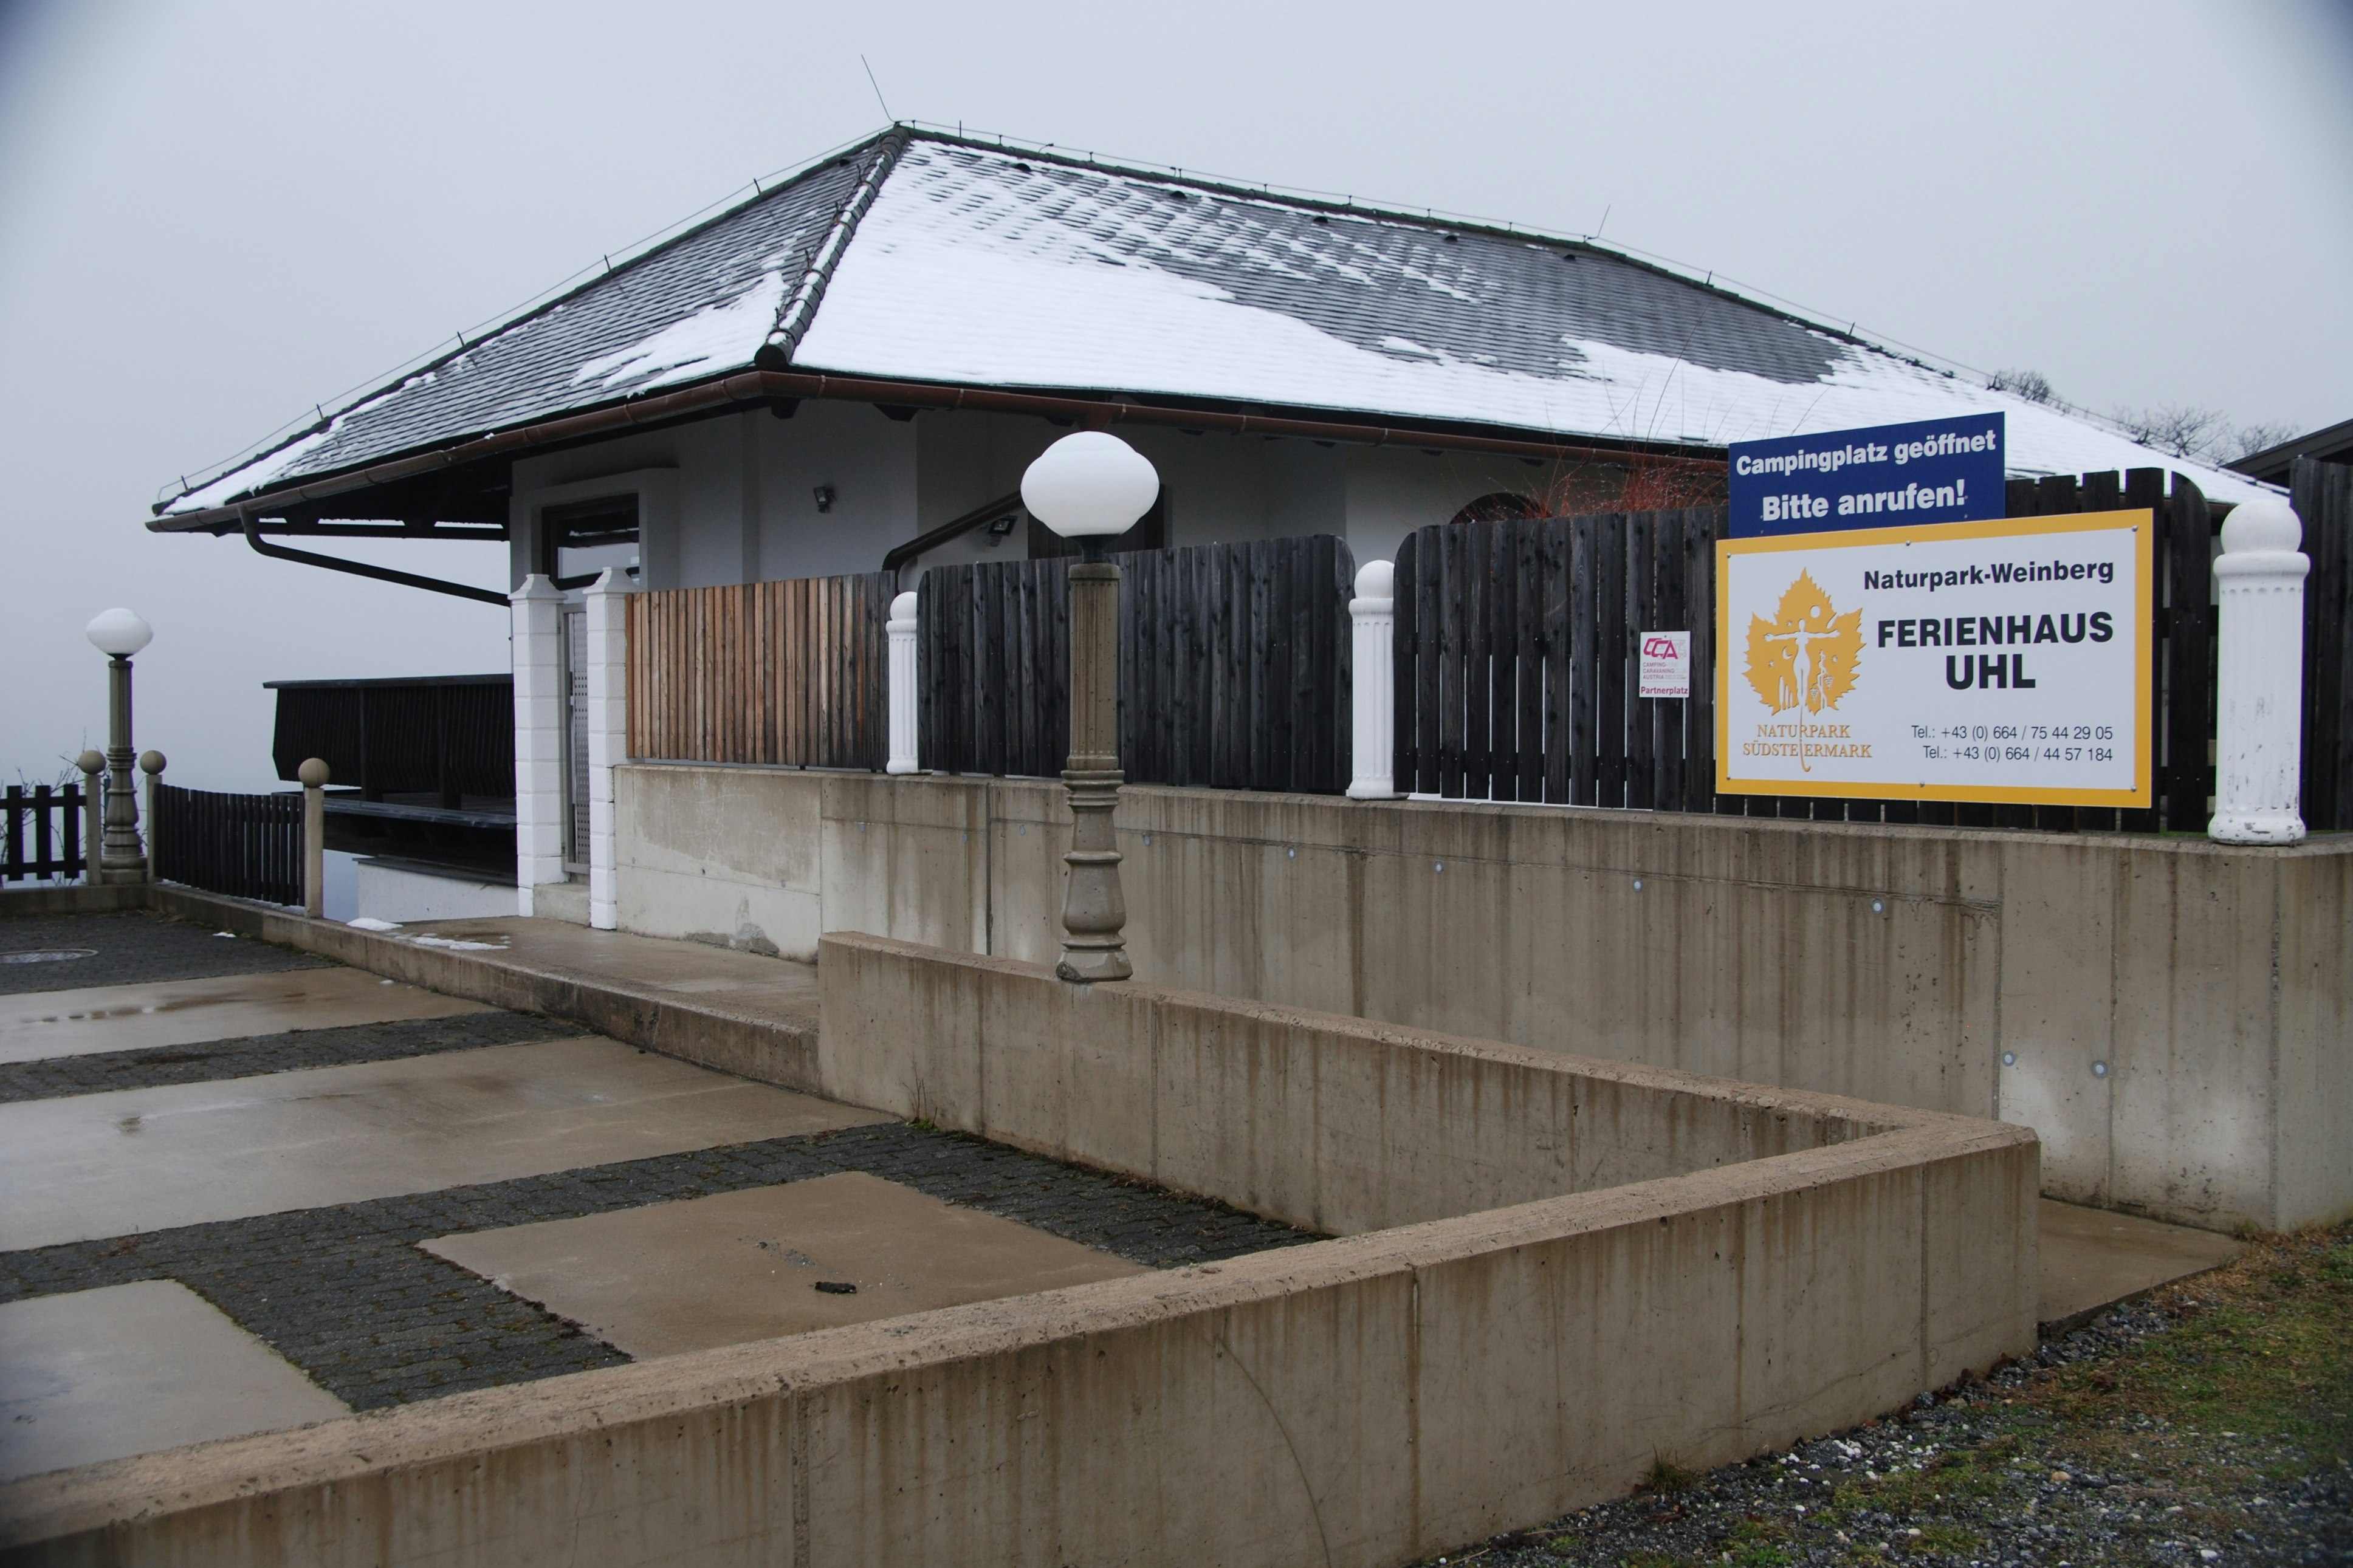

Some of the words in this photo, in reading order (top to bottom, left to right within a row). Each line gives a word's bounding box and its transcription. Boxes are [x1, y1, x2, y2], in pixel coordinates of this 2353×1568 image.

[1736, 443, 1888, 476] Campingplatz
[1895, 430, 1996, 464] geöffnet
[1763, 494, 1829, 521] Bitte
[1838, 479, 1965, 515] anrufen!
[1864, 561, 2114, 592] Naturpark-Weinberg
[1878, 612, 2114, 648] FERIENHAUS
[1643, 638, 1678, 659] CCA
[1946, 654, 2036, 690] UHL
[1641, 686, 1688, 695] Partnerplatz
[1757, 724, 1850, 738] NATURPARK
[1911, 725, 1936, 739] Tel.:
[1941, 726, 1967, 739] +43
[1972, 726, 1988, 742] (0)
[1993, 726, 2018, 739] 664
[2021, 726, 2027, 741] /
[2031, 727, 2047, 739] 75
[2052, 727, 2069, 739] 44
[2073, 727, 2091, 740] 29
[2095, 727, 2113, 740] 05
[1743, 739, 1872, 758] SÜDSTEIERMARK
[1923, 745, 1948, 759] Tel.:
[1953, 746, 1979, 759] +43
[1984, 747, 2001, 763] (0)
[2005, 747, 2030, 760] 664
[2034, 747, 2039, 762] /
[2043, 747, 2060, 761] 44
[2065, 748, 2082, 761] 57
[2088, 748, 2113, 761] 184
